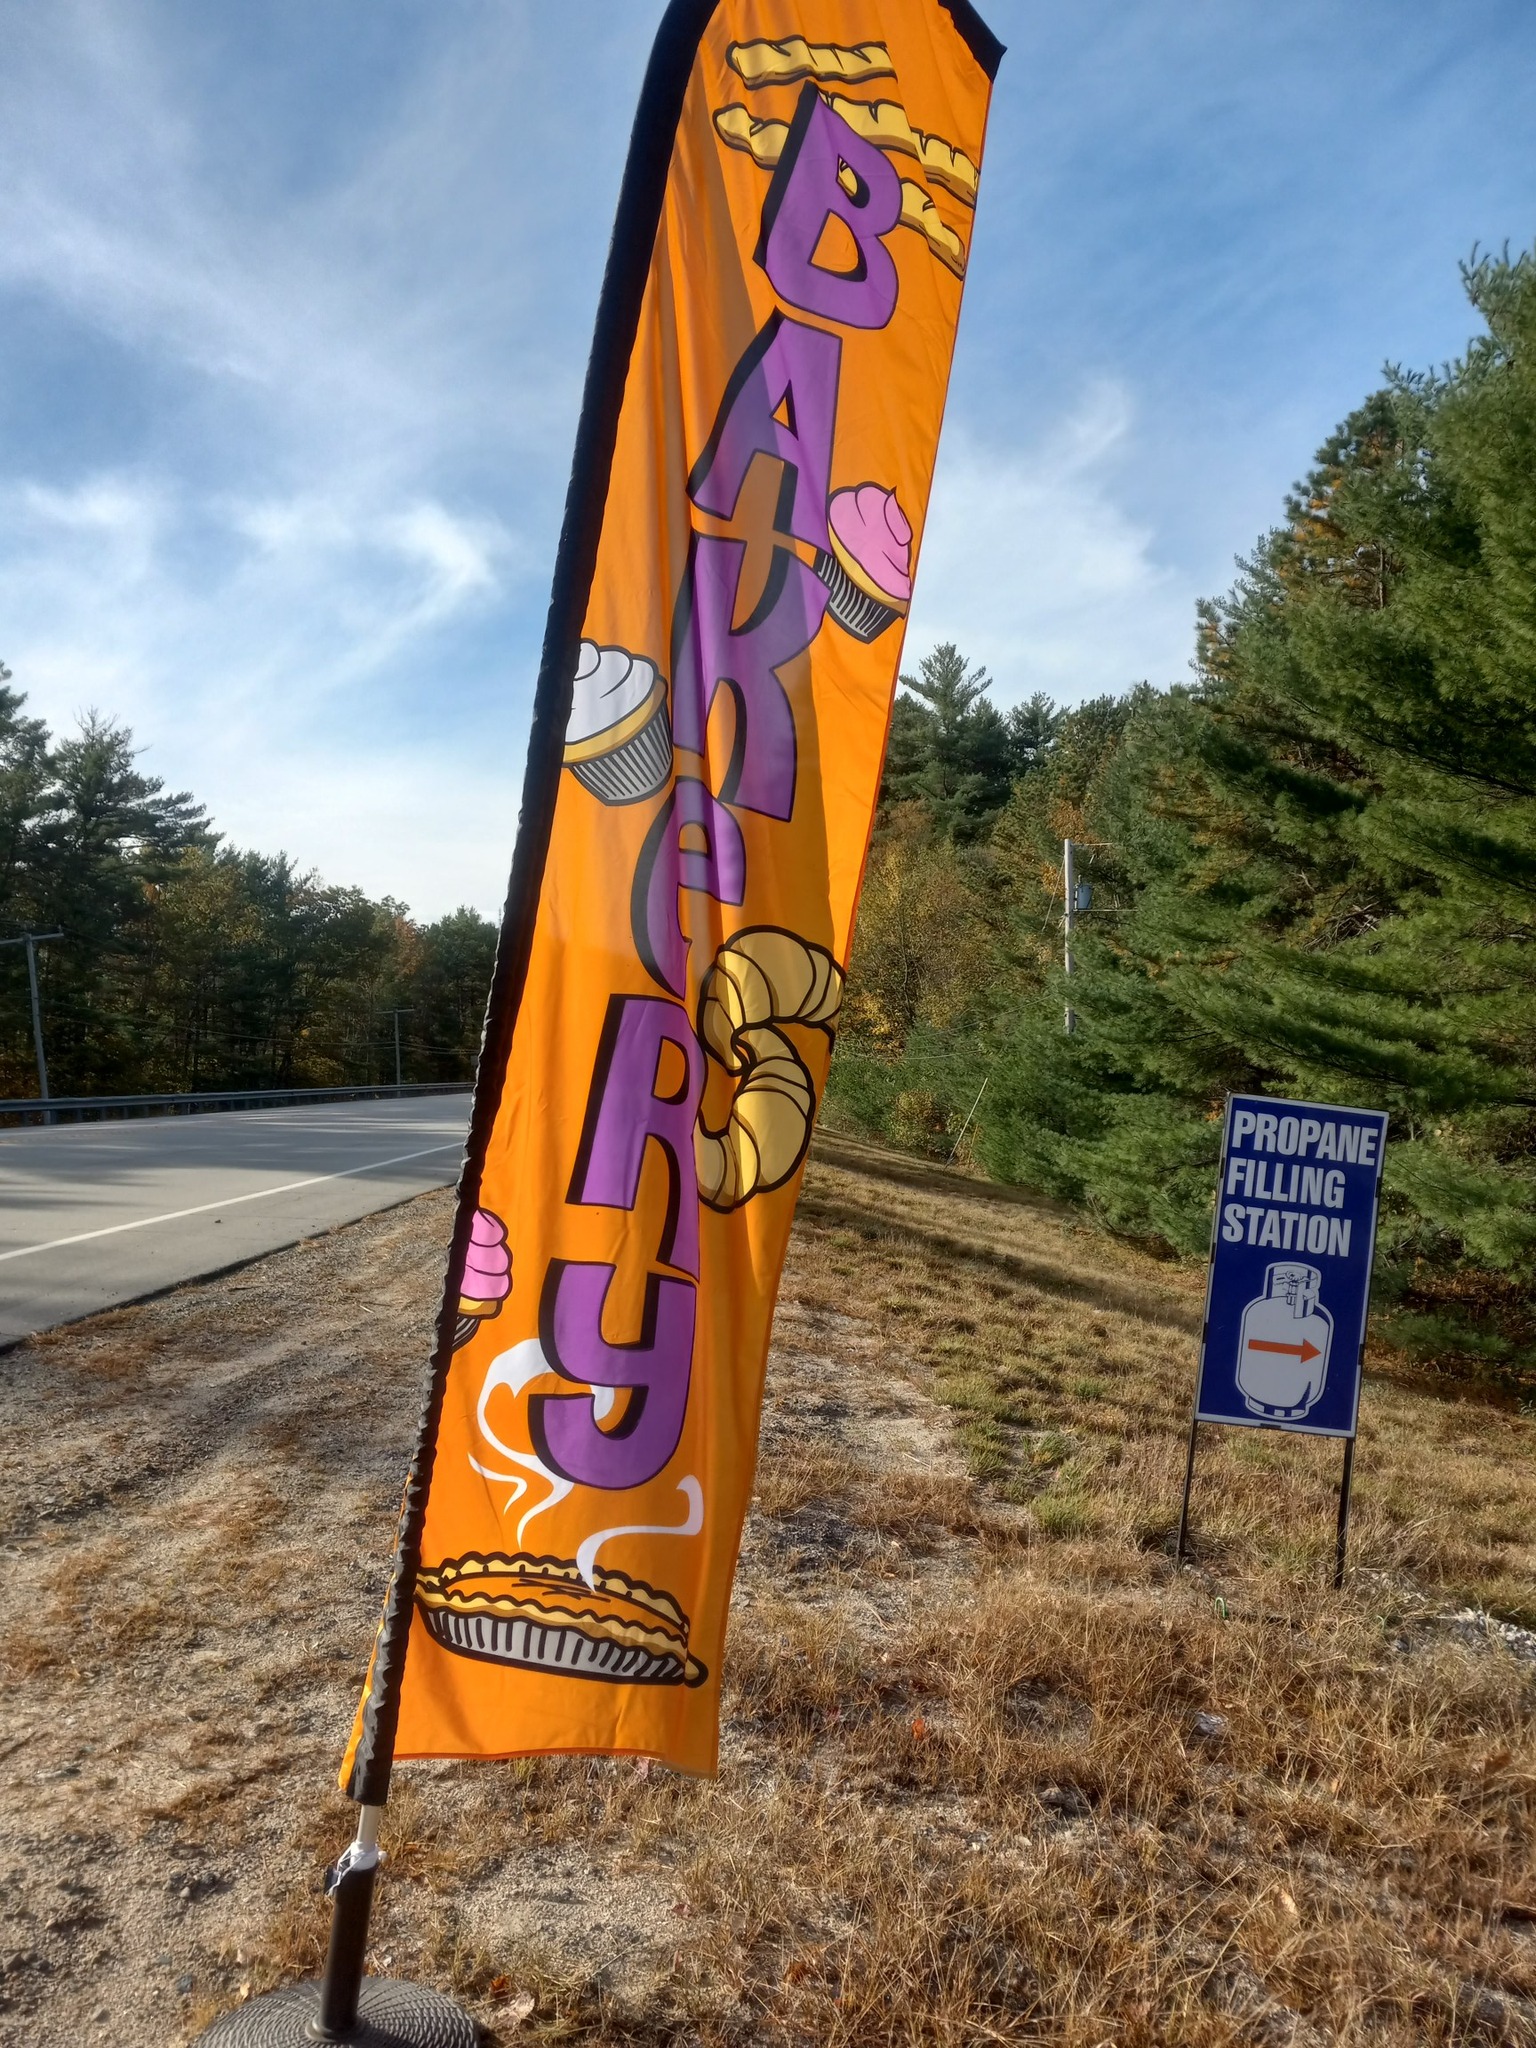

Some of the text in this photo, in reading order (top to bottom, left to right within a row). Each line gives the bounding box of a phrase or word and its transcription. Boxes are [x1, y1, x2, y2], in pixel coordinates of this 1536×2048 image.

[1232, 1110, 1378, 1166] PROPANE
[1227, 1157, 1346, 1209] FILLING
[1222, 1203, 1352, 1257] STATION
